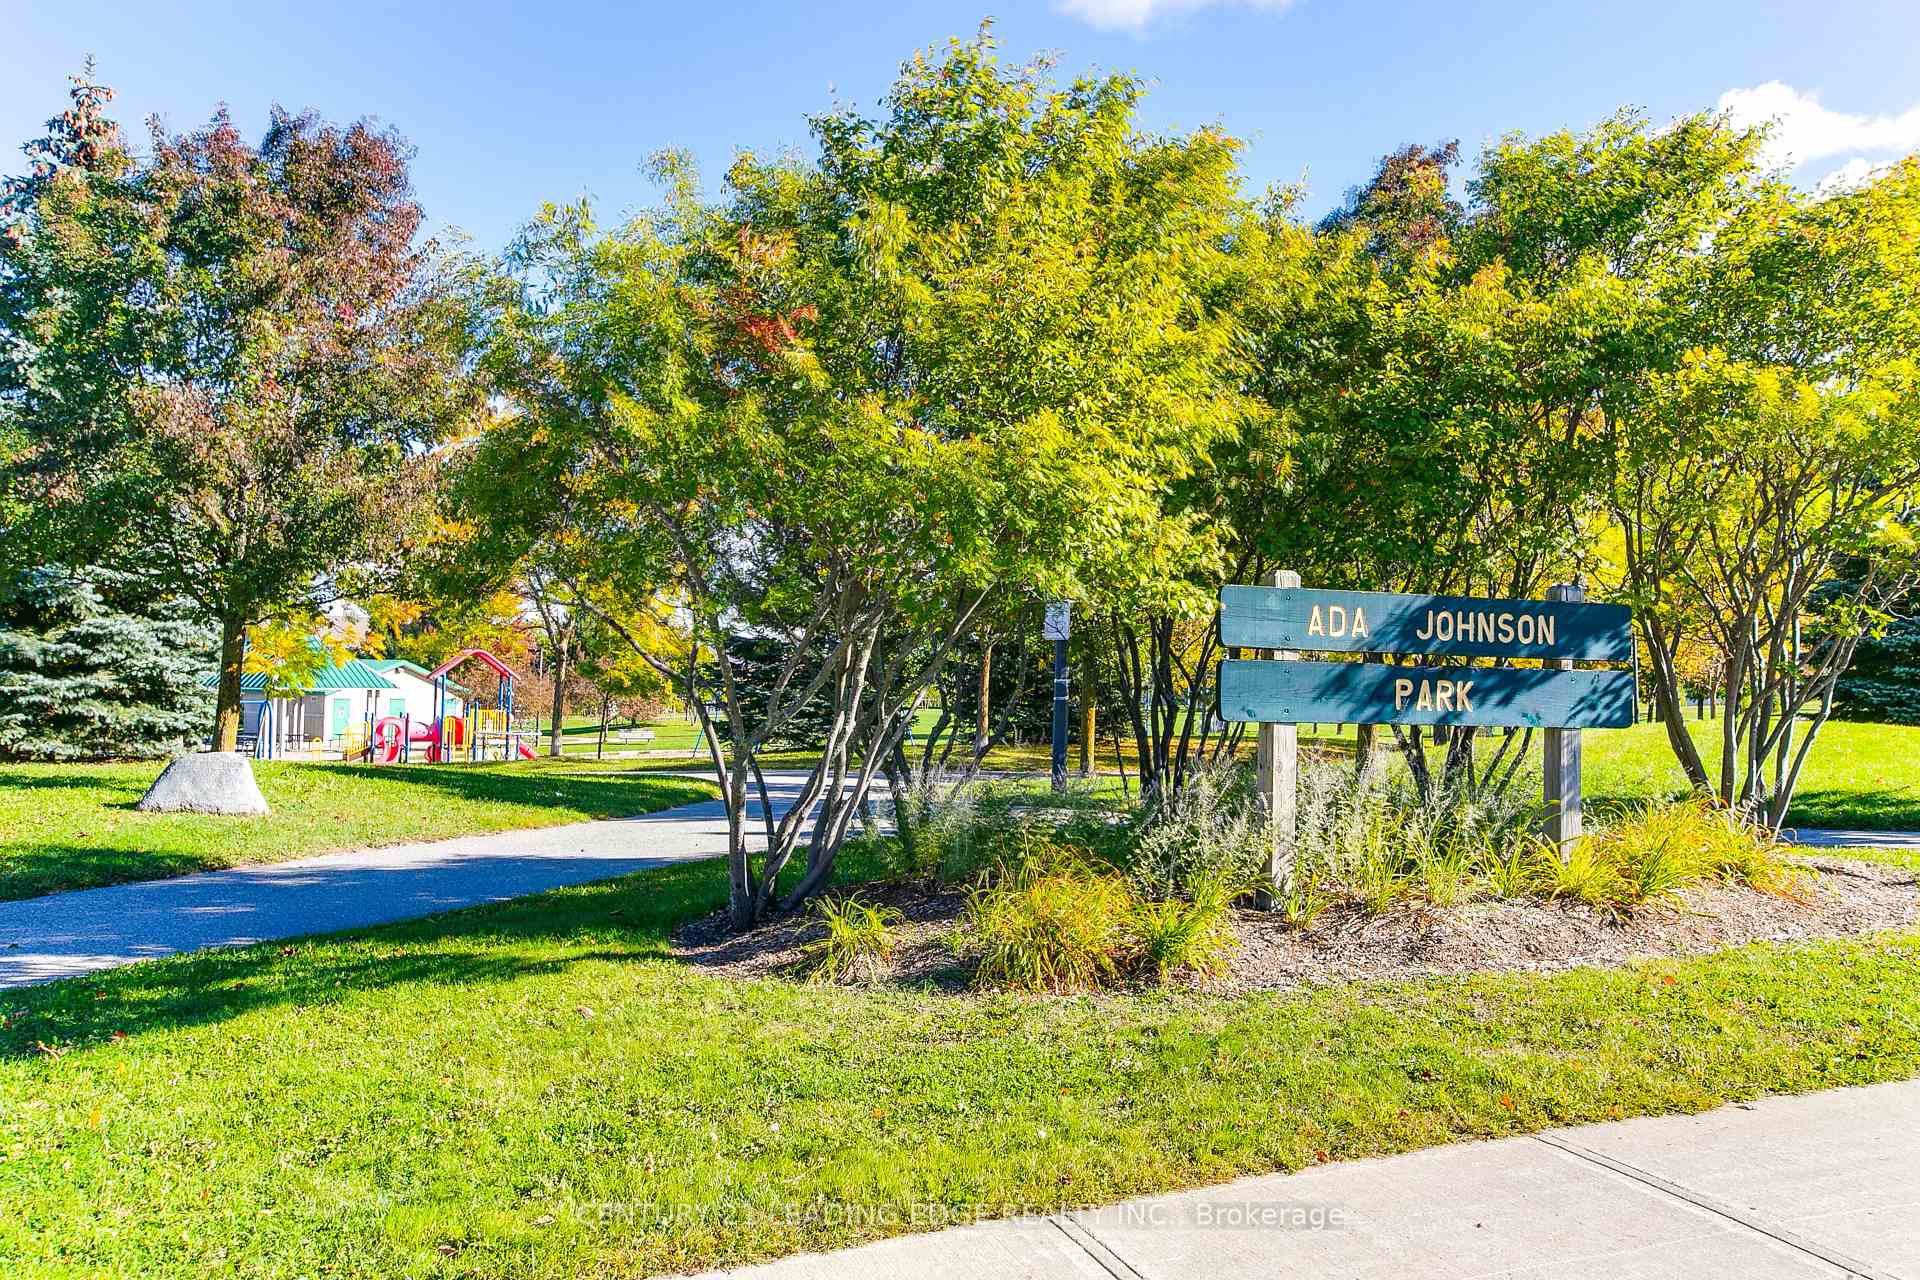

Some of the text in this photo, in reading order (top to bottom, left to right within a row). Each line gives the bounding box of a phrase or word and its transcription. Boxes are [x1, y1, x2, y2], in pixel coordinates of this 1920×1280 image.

[1307, 604, 1556, 646] ADA JOHNSON
[1394, 678, 1474, 713] PARK
